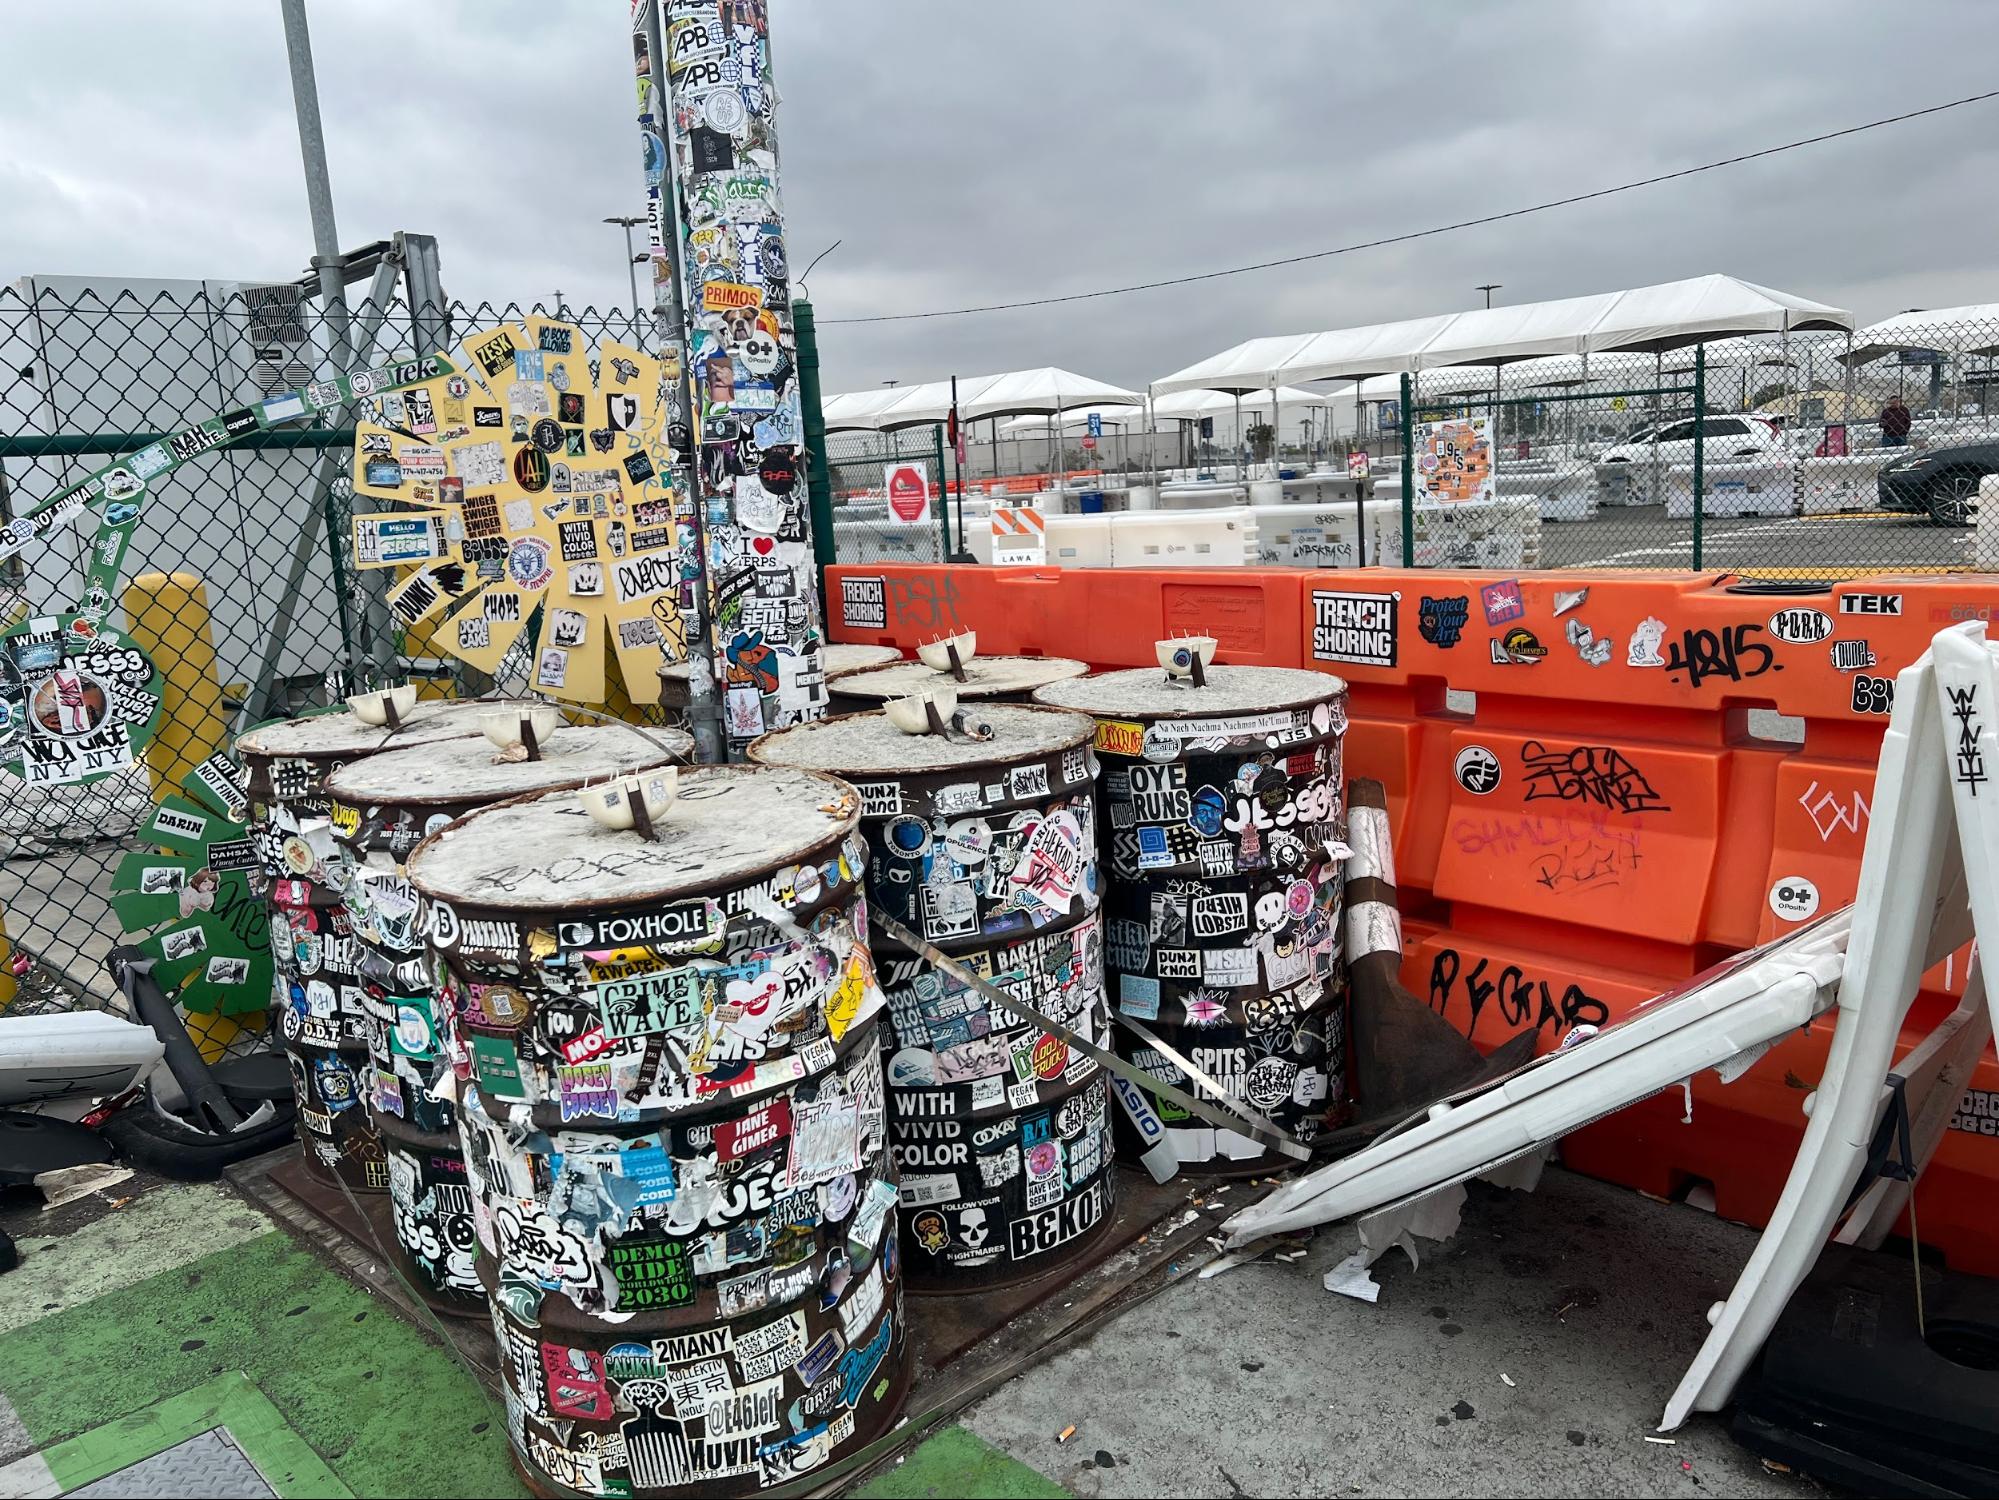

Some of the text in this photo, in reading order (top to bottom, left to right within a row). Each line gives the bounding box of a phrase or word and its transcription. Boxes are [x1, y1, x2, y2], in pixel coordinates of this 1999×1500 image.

[682, 62, 721, 91] APB
[706, 287, 758, 306] PRIMOS
[539, 327, 550, 340] NO
[477, 334, 512, 364] ZESK
[395, 360, 431, 384] tek
[1090, 418, 1100, 428] 31
[33, 487, 92, 533] NOT FINNA
[463, 506, 498, 521] SWIGER
[388, 523, 416, 532] HELLO
[465, 517, 501, 532] SWIGER
[563, 521, 588, 534] WITH
[563, 541, 595, 554] COLOR
[564, 532, 591, 544] VIVID
[841, 581, 882, 604] TRENCH
[484, 594, 519, 621] CHOPS
[843, 602, 884, 622] SHORING
[1313, 598, 1391, 631] TRENCH
[1422, 597, 1467, 615] Protect
[1841, 595, 1900, 614] TEK
[1436, 610, 1467, 629] Your
[14, 631, 54, 646] WITH
[1313, 626, 1391, 657] SHORING
[1318, 653, 1386, 665] COMPANY
[110, 680, 158, 705] VELOZ
[1158, 723, 1170, 733] Na
[1171, 722, 1191, 734] Nach
[1191, 721, 1222, 733] Nachma
[83, 748, 126, 770] NY
[31, 761, 75, 782] NY
[198, 765, 220, 787] NOT
[1130, 765, 1185, 792] OYE
[1134, 790, 1190, 822] RUNS
[157, 813, 203, 833] DARIN
[946, 838, 988, 855] OPULENCE
[1207, 860, 1235, 877] TDK
[599, 907, 704, 944] FOXHOLE
[1194, 914, 1246, 934] LOBSTA
[999, 940, 1038, 969] BARZ
[1204, 951, 1259, 969] VISAH
[604, 972, 690, 1008] CRIME
[606, 1000, 692, 1040] WAVE
[804, 1040, 831, 1062] VEGAN
[1191, 1047, 1246, 1075] SPITS
[811, 1052, 832, 1071] DIET
[1010, 1084, 1035, 1098] VEGAN
[1017, 1094, 1034, 1107] DIET
[894, 1092, 956, 1116] WITH
[735, 1111, 770, 1137] JANE
[893, 1121, 961, 1139] VIVID
[1023, 1119, 1049, 1142] R/T
[731, 1124, 779, 1156] GIMER
[895, 1143, 968, 1167] COLOR
[1029, 1177, 1061, 1197] HAVE YOU
[1029, 1187, 1062, 1207] SEEN HIM
[773, 1189, 811, 1217] TRAP
[941, 1196, 1000, 1211] FOLLOW YOUR
[768, 1203, 814, 1234] SHACK
[613, 1242, 681, 1263] DEMO
[946, 1244, 1006, 1262] NIGHTMARES
[614, 1258, 685, 1283] CIDE
[617, 1274, 685, 1291] WORLDWIDE
[769, 1276, 788, 1298] GET
[787, 1266, 814, 1289] MORE
[620, 1284, 689, 1307] 2030
[763, 1317, 791, 1335] MAKA
[765, 1325, 790, 1342] LASSI
[655, 1327, 729, 1365] 2MANY
[735, 1332, 764, 1350] MAKA
[735, 1341, 763, 1356] LASSI
[767, 1331, 793, 1347] POSSE
[777, 1339, 803, 1357] MAKA
[738, 1347, 764, 1361] POSSE
[745, 1354, 773, 1370] MAKA
[777, 1346, 805, 1365] LASSI
[779, 1352, 805, 1372] POSSE
[667, 1359, 725, 1383] KOLLEKTIV
[745, 1361, 773, 1377] LASSI
[747, 1367, 774, 1383] POSSE
[673, 1370, 730, 1407] 東京
[828, 1413, 852, 1437] VEGAN
[832, 1425, 851, 1445] DIET
